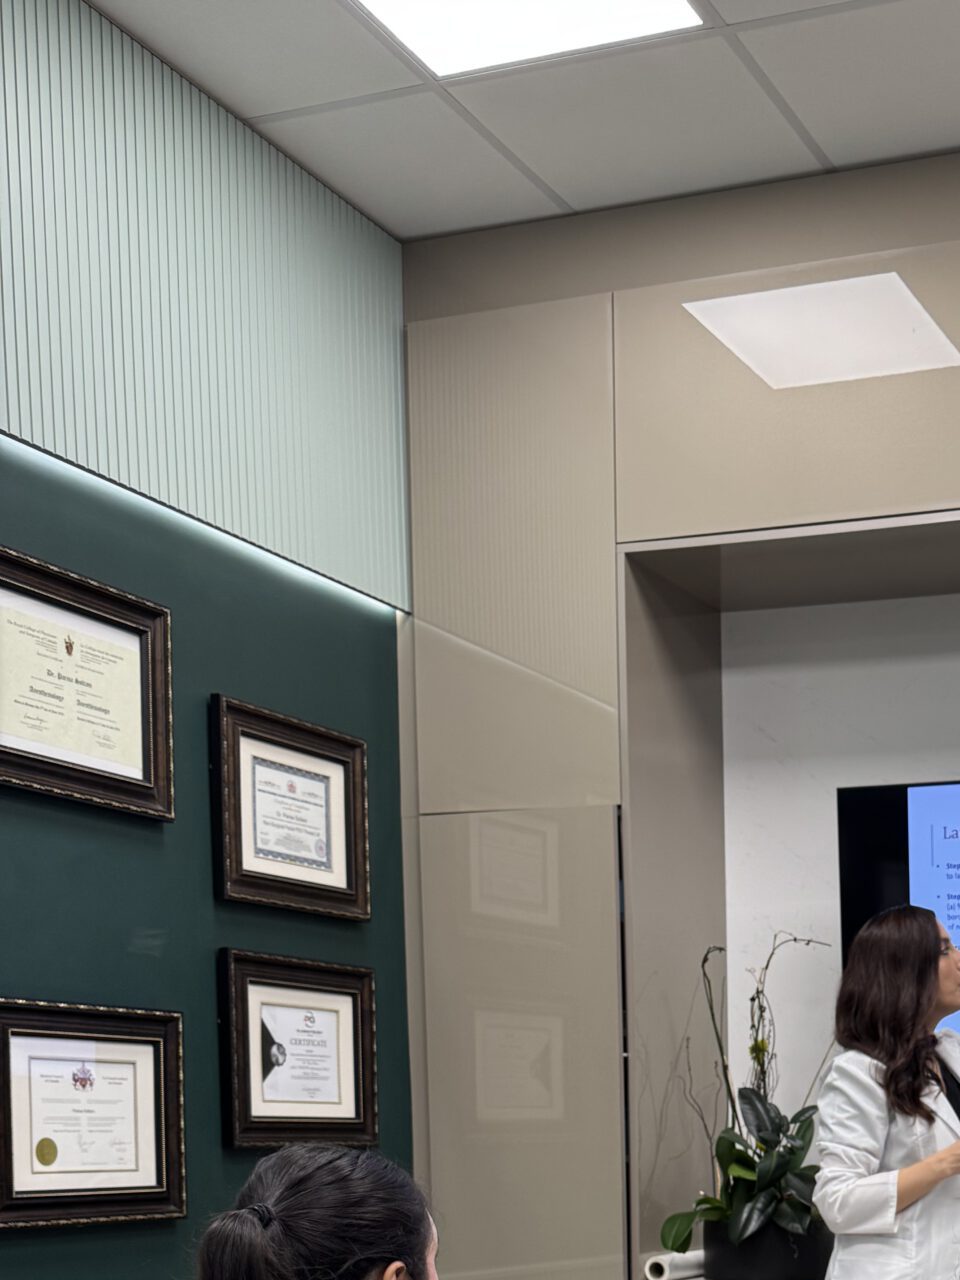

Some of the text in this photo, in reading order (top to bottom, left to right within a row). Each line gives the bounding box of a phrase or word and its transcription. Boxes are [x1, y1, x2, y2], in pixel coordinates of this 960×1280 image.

[946, 862, 960, 871] Step
[946, 872, 953, 880] to
[946, 893, 960, 902] Step
[948, 922, 955, 930] of
